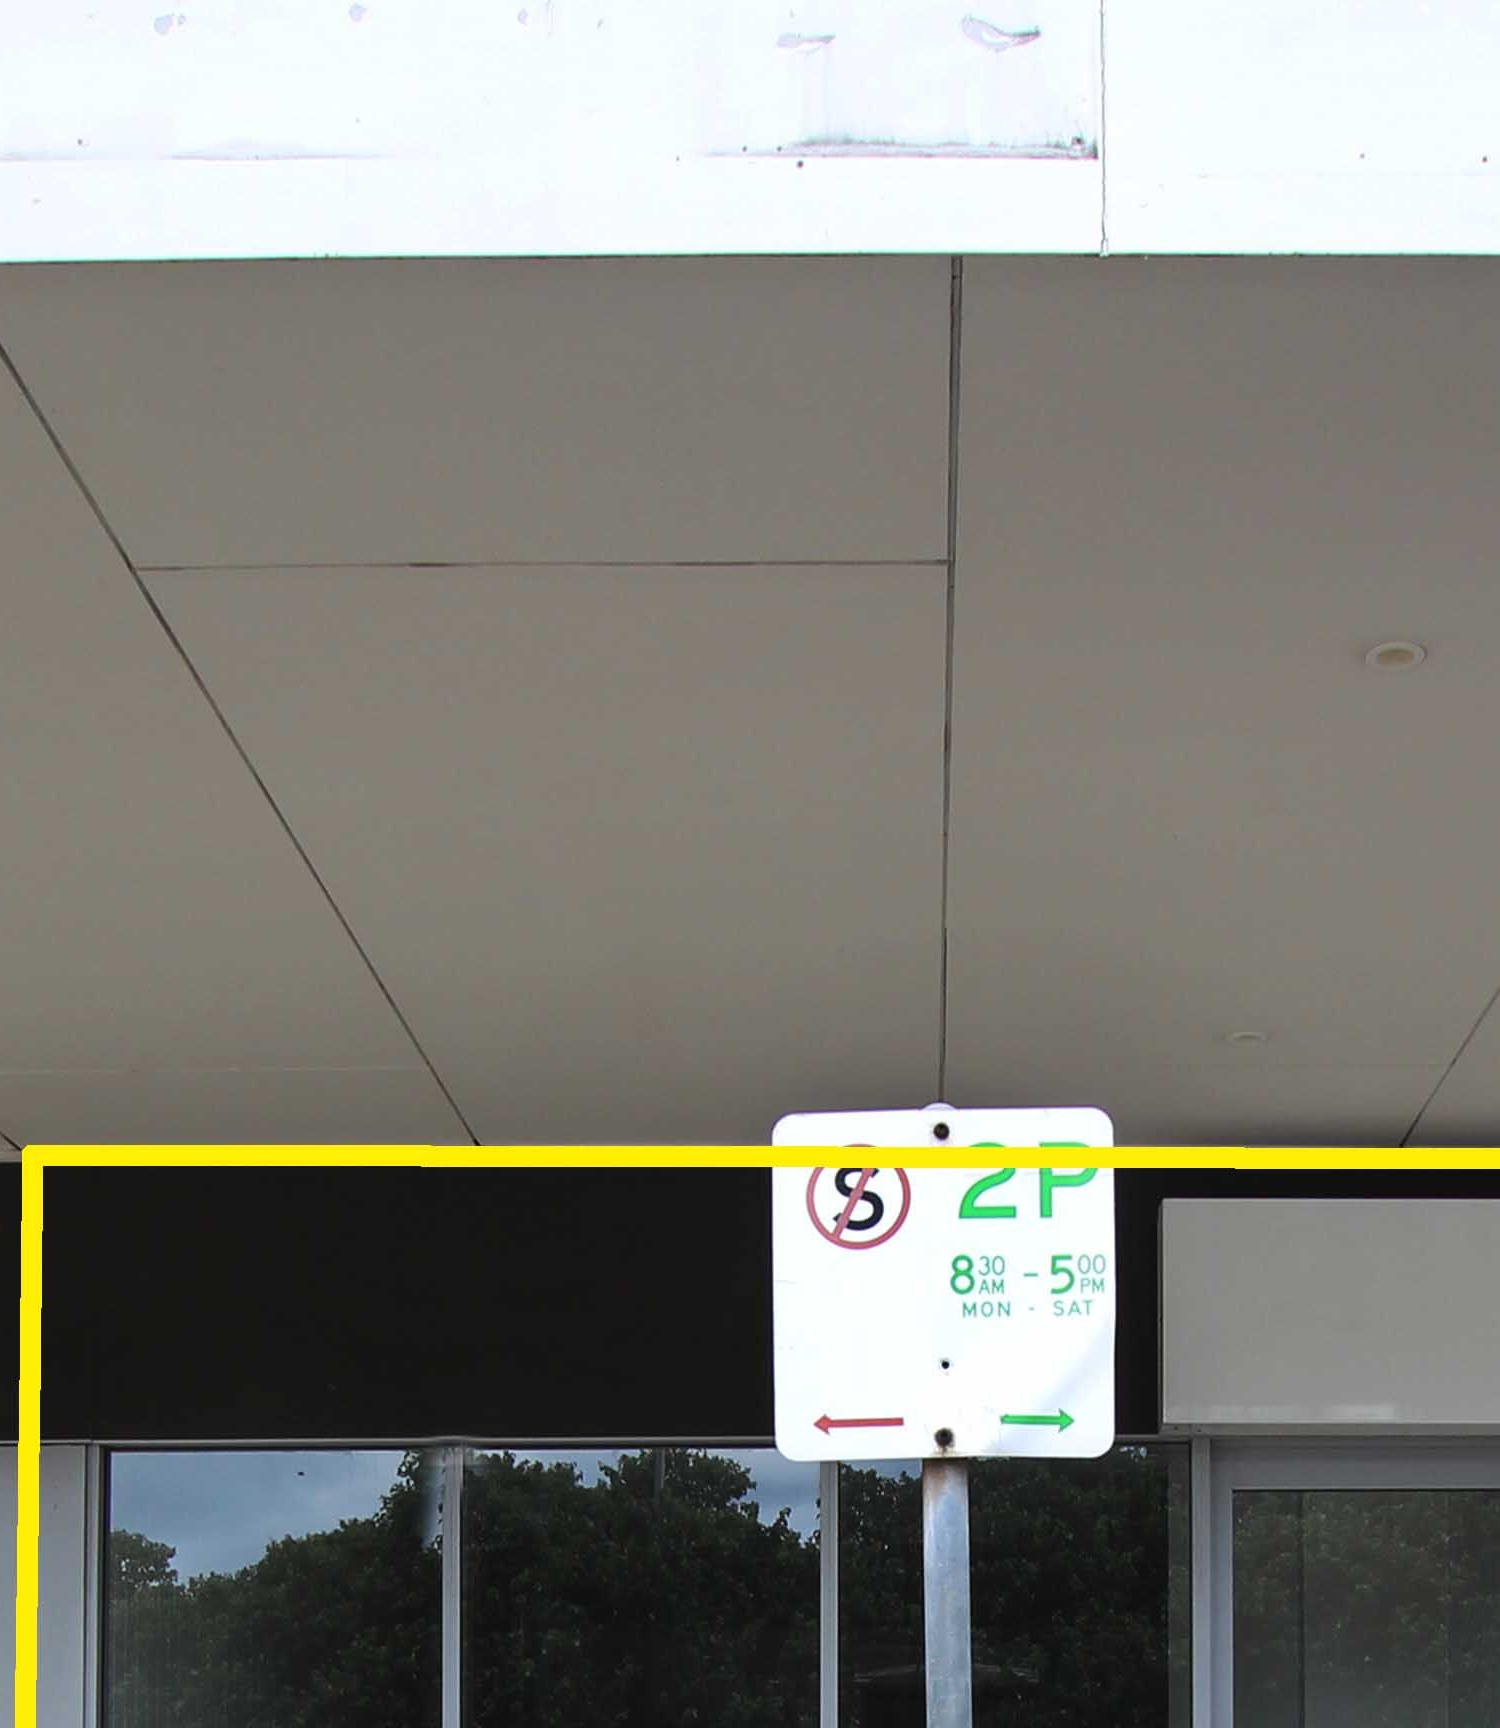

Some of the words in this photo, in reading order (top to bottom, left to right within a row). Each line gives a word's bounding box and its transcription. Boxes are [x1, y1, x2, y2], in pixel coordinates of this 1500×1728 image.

[959, 1141, 1100, 1219] 2P
[962, 1300, 1011, 1318] MON
[1053, 1299, 1093, 1317] SAT
